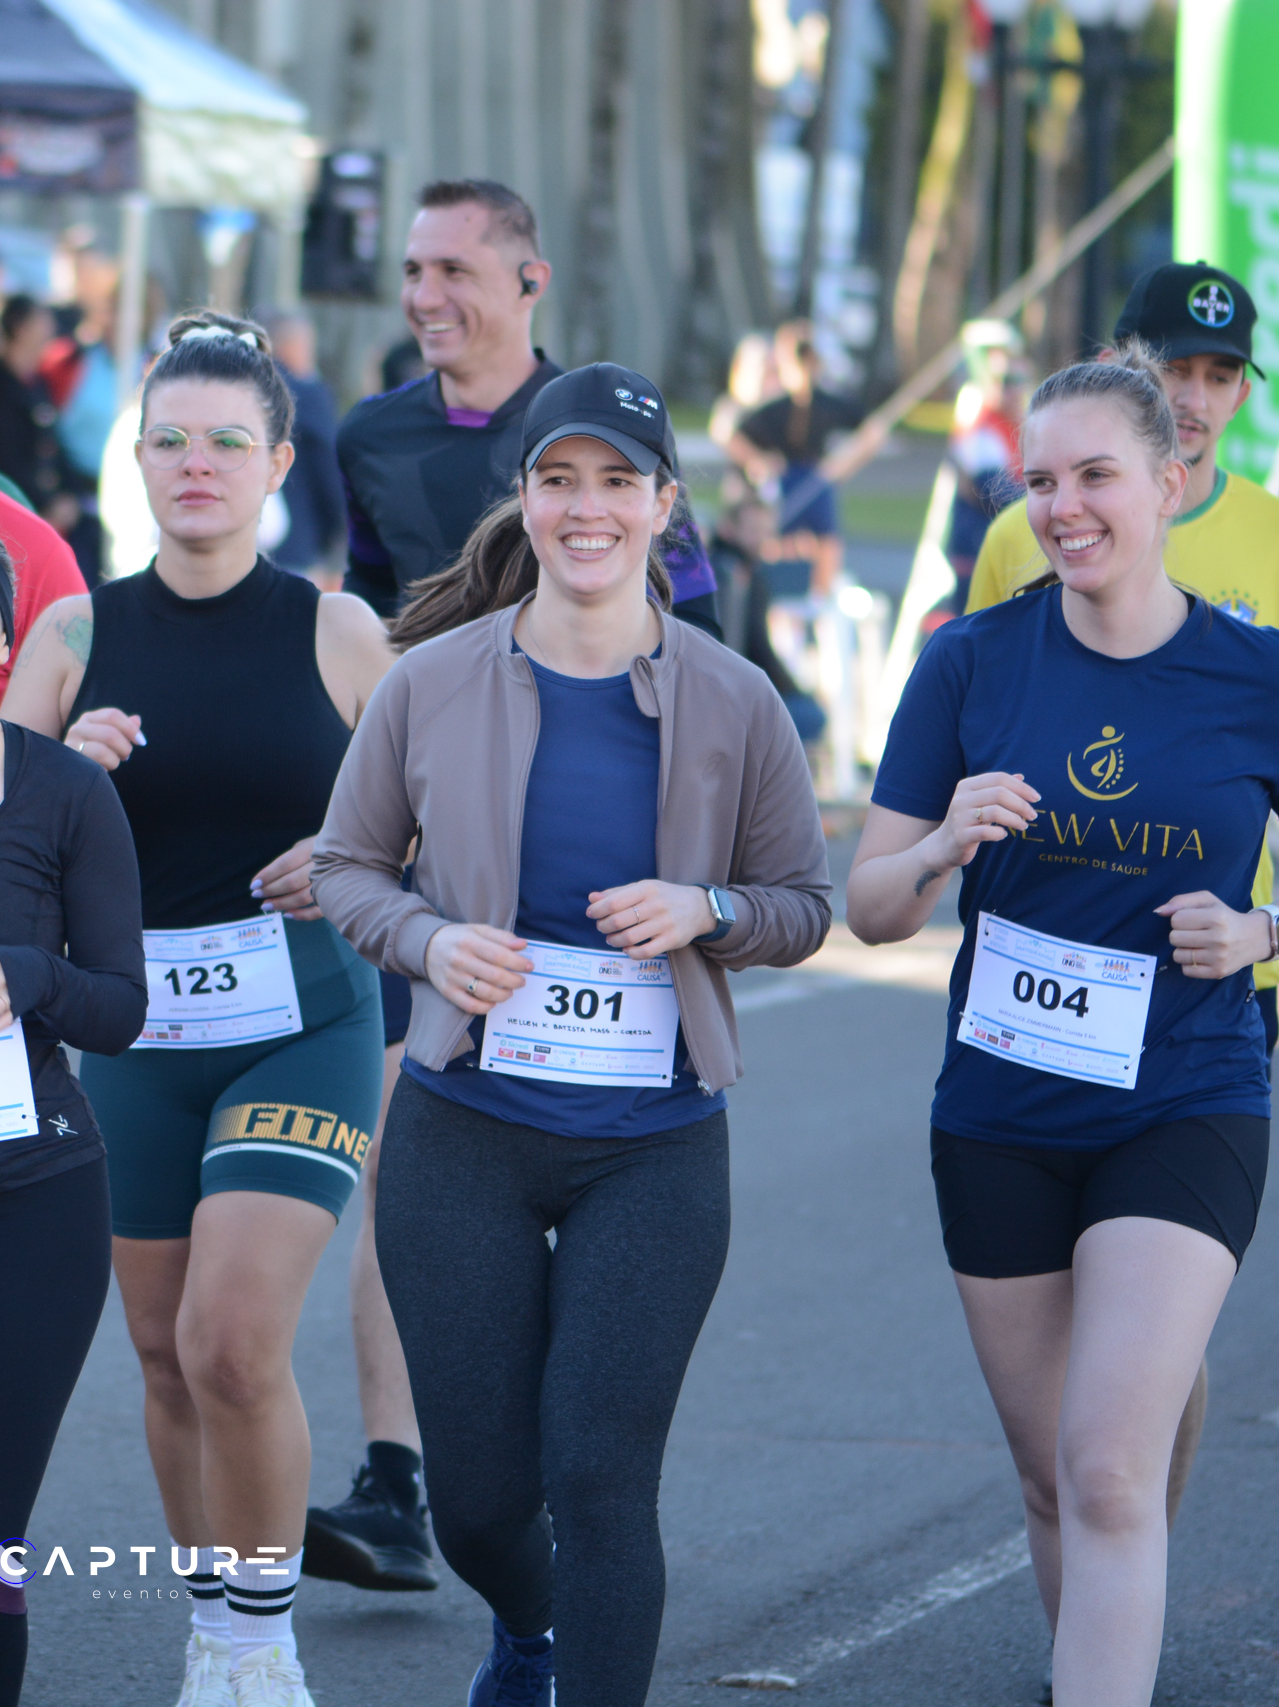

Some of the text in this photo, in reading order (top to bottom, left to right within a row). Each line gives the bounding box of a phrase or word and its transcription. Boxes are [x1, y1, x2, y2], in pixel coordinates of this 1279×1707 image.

[995, 808, 1203, 860] EW VITA
[1039, 853, 1148, 876] CENTRO DE SAÚDE
[164, 962, 238, 996] 123
[1013, 970, 1089, 1019] 004
[544, 984, 623, 1022] 301
